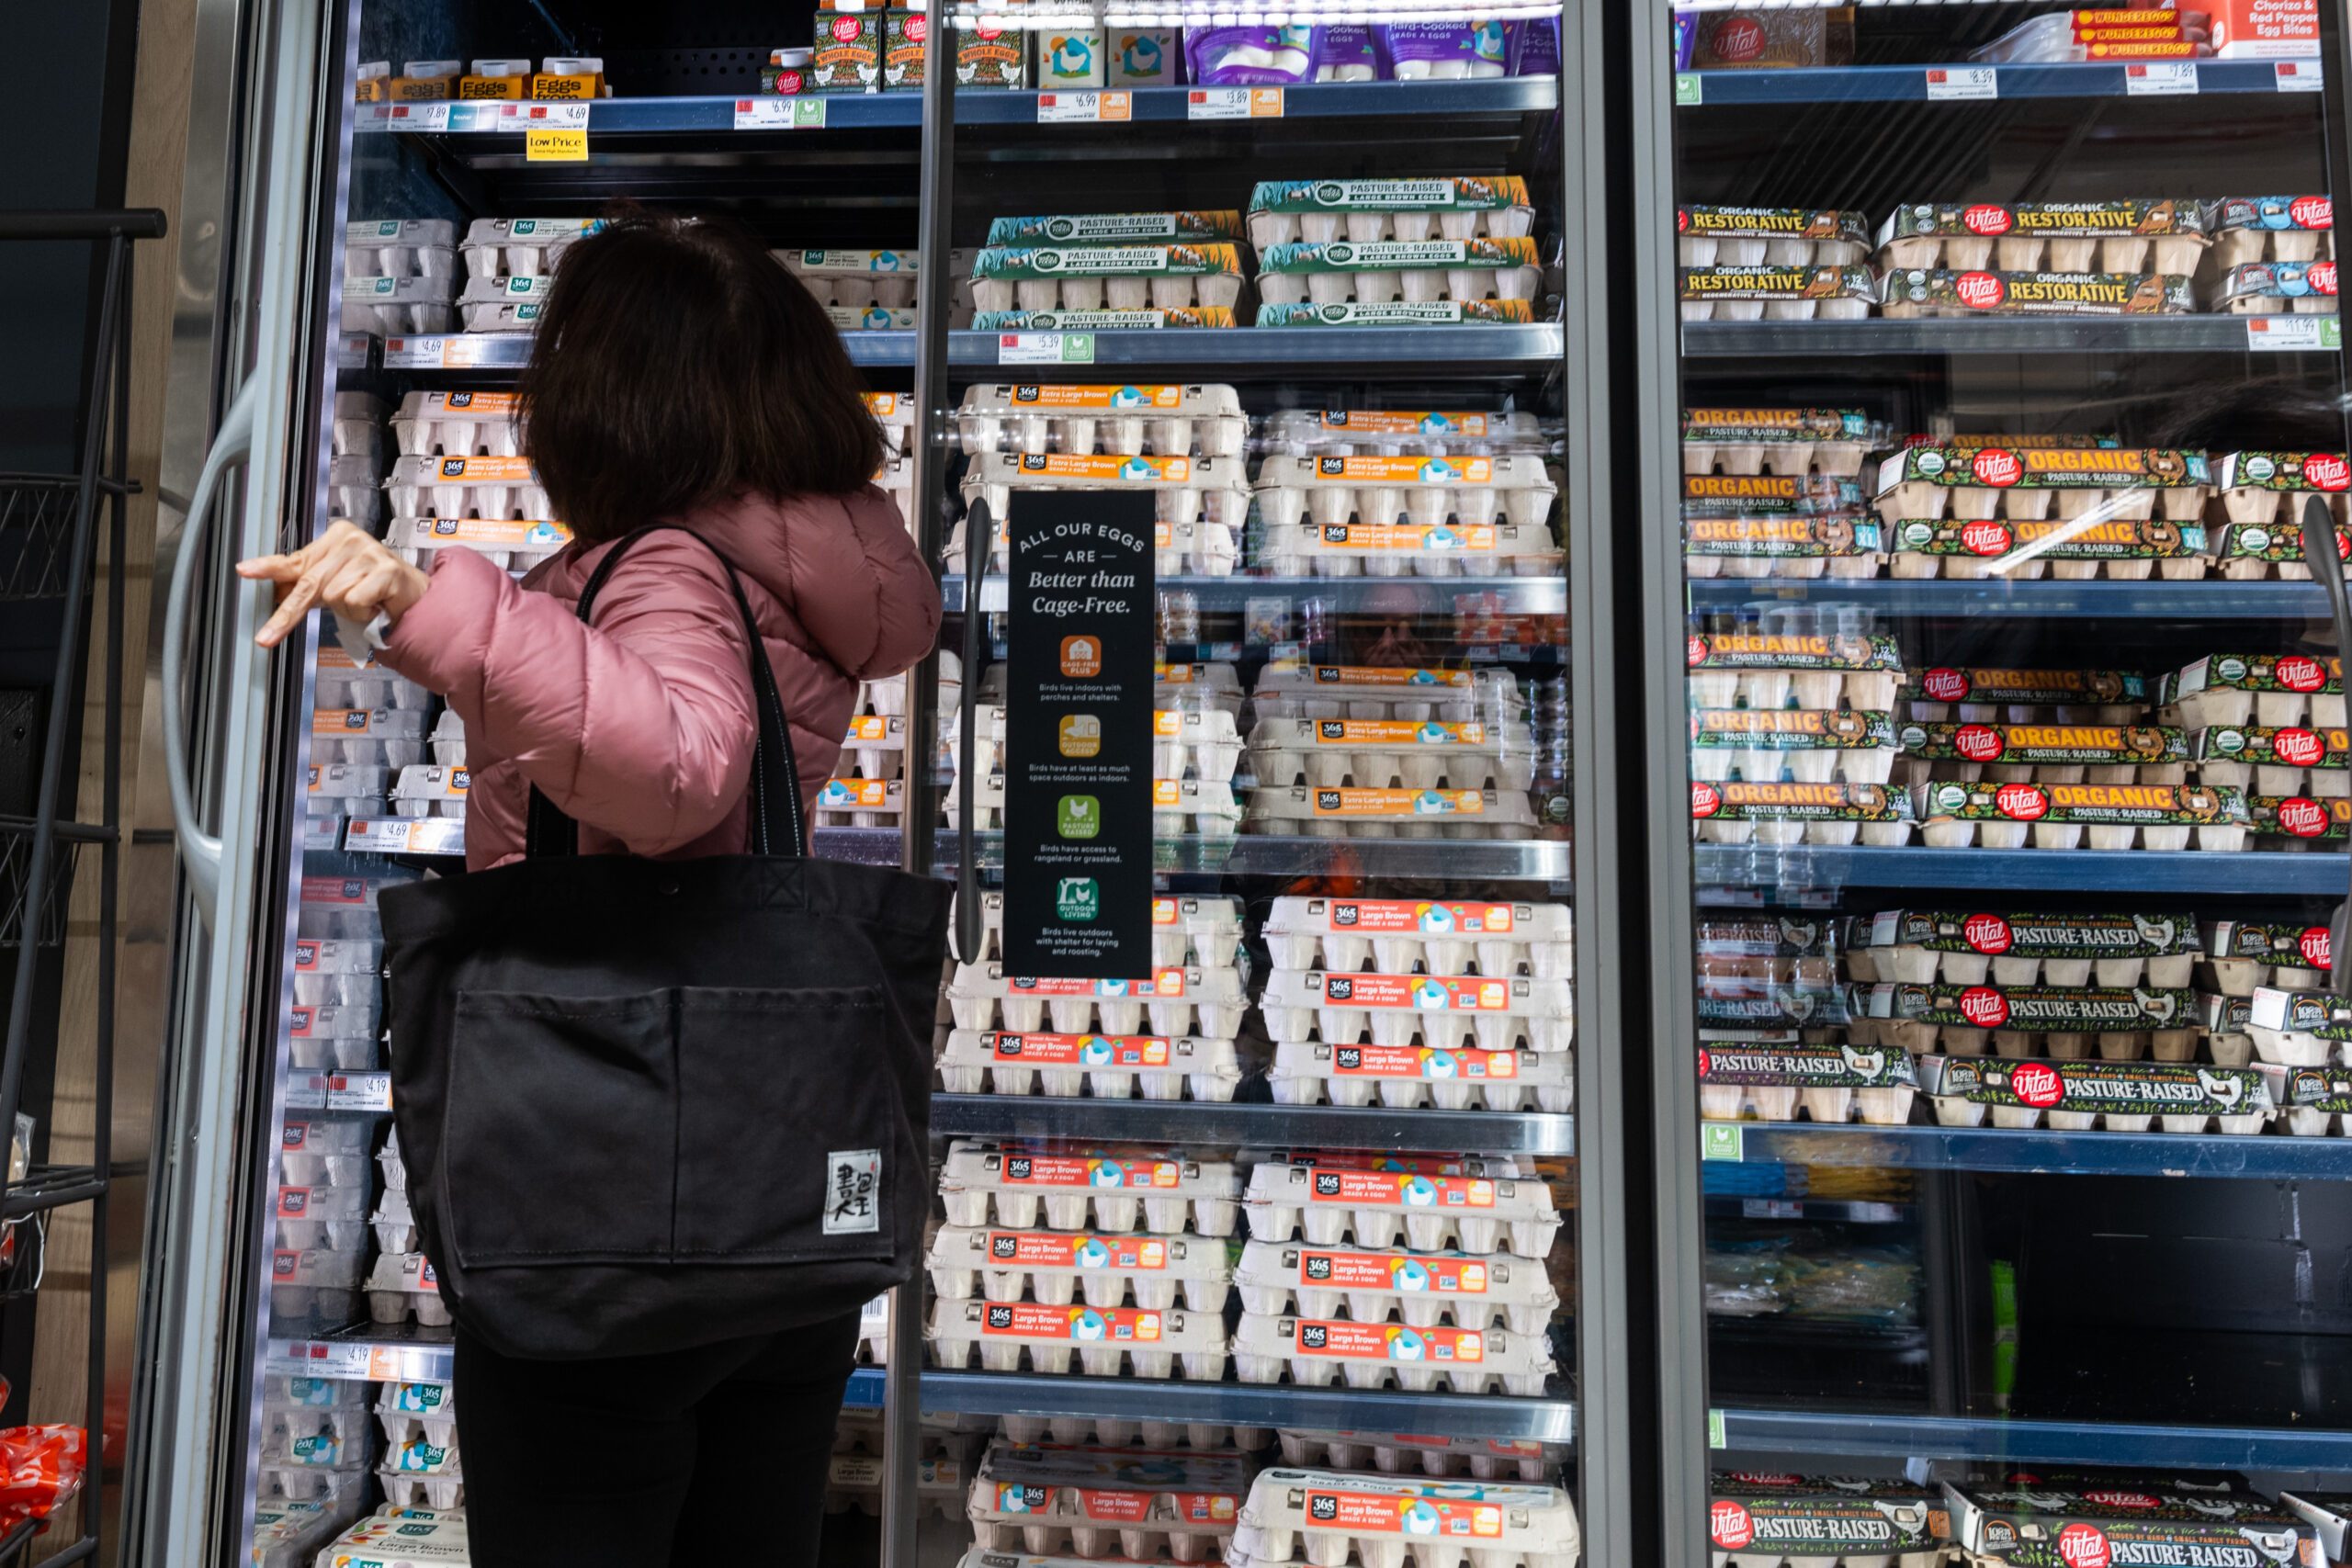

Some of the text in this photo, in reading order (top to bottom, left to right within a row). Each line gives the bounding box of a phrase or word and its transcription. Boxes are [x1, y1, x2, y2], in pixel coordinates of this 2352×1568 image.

[2253, 0, 2314, 12] Chorizo &
[2249, 13, 2318, 26] Red Pepper
[832, 19, 858, 35] Vital
[1388, 21, 1467, 31] Hard-Cooked
[2256, 24, 2312, 37] Egg Bites
[819, 50, 874, 63] WHOLE EGGS
[963, 48, 1016, 62] WHOLE EGGS
[463, 81, 507, 96] Eggs
[537, 79, 582, 94] Eggs
[1076, 95, 1096, 107] $6.99
[1227, 92, 1248, 104] $3.89
[427, 107, 447, 118] $7.89
[772, 100, 792, 113] $6.99
[566, 107, 586, 119] $4.69
[530, 137, 582, 147] Low Price
[1350, 184, 1443, 193] PASTURE-RAISED
[1718, 207, 1774, 217] ORGANIC
[2043, 203, 2106, 212] ORGANIC
[1080, 217, 1166, 228] PASTURE-RAISED
[1693, 214, 1805, 231] RESTORATIVE
[2017, 210, 2138, 228] RESTORATIVE
[516, 221, 535, 231] 365
[1360, 243, 1453, 253] PASTURE-RAISED
[1067, 251, 1157, 260] PASTURE-RAISED
[1715, 266, 1775, 276] ORGANIC
[513, 279, 531, 289] 365
[1689, 275, 1805, 290] RESTORATIVE
[2036, 274, 2097, 284] ORGANIC
[2009, 282, 2129, 302] RESTORATIVE
[422, 341, 442, 353] $4.69
[1038, 336, 1058, 348] $5.39
[1018, 387, 1038, 397] 365
[1062, 390, 1082, 400] Large
[1694, 411, 1801, 426] ORGANIC
[445, 460, 464, 470] 365
[1322, 458, 1342, 469] 365
[1367, 463, 1389, 472] Large
[2029, 451, 2141, 472] ORGANIC
[487, 464, 504, 472] Large
[2307, 462, 2346, 480] Vital
[1690, 478, 1794, 496] ORGANIC
[1019, 523, 1145, 553] ALL OUR EGGS
[1064, 550, 1096, 563] ARE
[1028, 570, 1136, 588] Better than
[1033, 597, 1131, 617] Cage-Free.
[1715, 636, 1826, 653] ORGANIC
[2278, 663, 2318, 682] Vital
[1041, 694, 1070, 702] perches
[1088, 694, 1120, 702] shelters.
[1323, 722, 1343, 733] 365
[1367, 727, 1388, 736] Large
[2009, 728, 2119, 749] ORGANIC
[1029, 774, 1051, 783] space
[1727, 784, 1838, 804] ORGANIC
[2053, 787, 2171, 807] ORGANIC
[1745, 806, 1829, 815] PASTURE-RAISED
[2074, 807, 2162, 818] PASTURE-RAISED
[387, 823, 407, 836] $4.69
[1035, 854, 1071, 863] rangeland
[1083, 855, 1123, 863] grassland.
[1336, 907, 1356, 919] 365
[1361, 911, 1410, 921] Large Brown
[1042, 928, 1061, 936] Birds
[1063, 928, 1077, 936] live
[2013, 927, 2139, 946] PASTURE-RAISED
[1095, 939, 1119, 948] laying
[1052, 947, 1102, 957] and roosting.
[2008, 999, 2139, 1019] PASTURE-RAISED
[1711, 1055, 1846, 1075] PASTURE-RAISED
[367, 1079, 387, 1093] $4.19
[2014, 1074, 2056, 1095] Vital
[2064, 1077, 2203, 1101] PASTURE-RAISED
[1308, 1259, 1329, 1271] 365
[1334, 1265, 1385, 1276] Large Brown
[990, 1308, 1011, 1320] 365
[1014, 1313, 1063, 1325] Large Brown
[348, 1345, 368, 1361] $4.19
[424, 1388, 440, 1399] 365
[1313, 1498, 1335, 1512] 365
[1340, 1504, 1393, 1517] Large Brown
[1713, 1513, 1747, 1535] Vital
[1754, 1518, 1891, 1540] PASTURE-RAISED
[2062, 1533, 2103, 1556] Vital
[2111, 1541, 2257, 1568] PASTURE-RAISED
